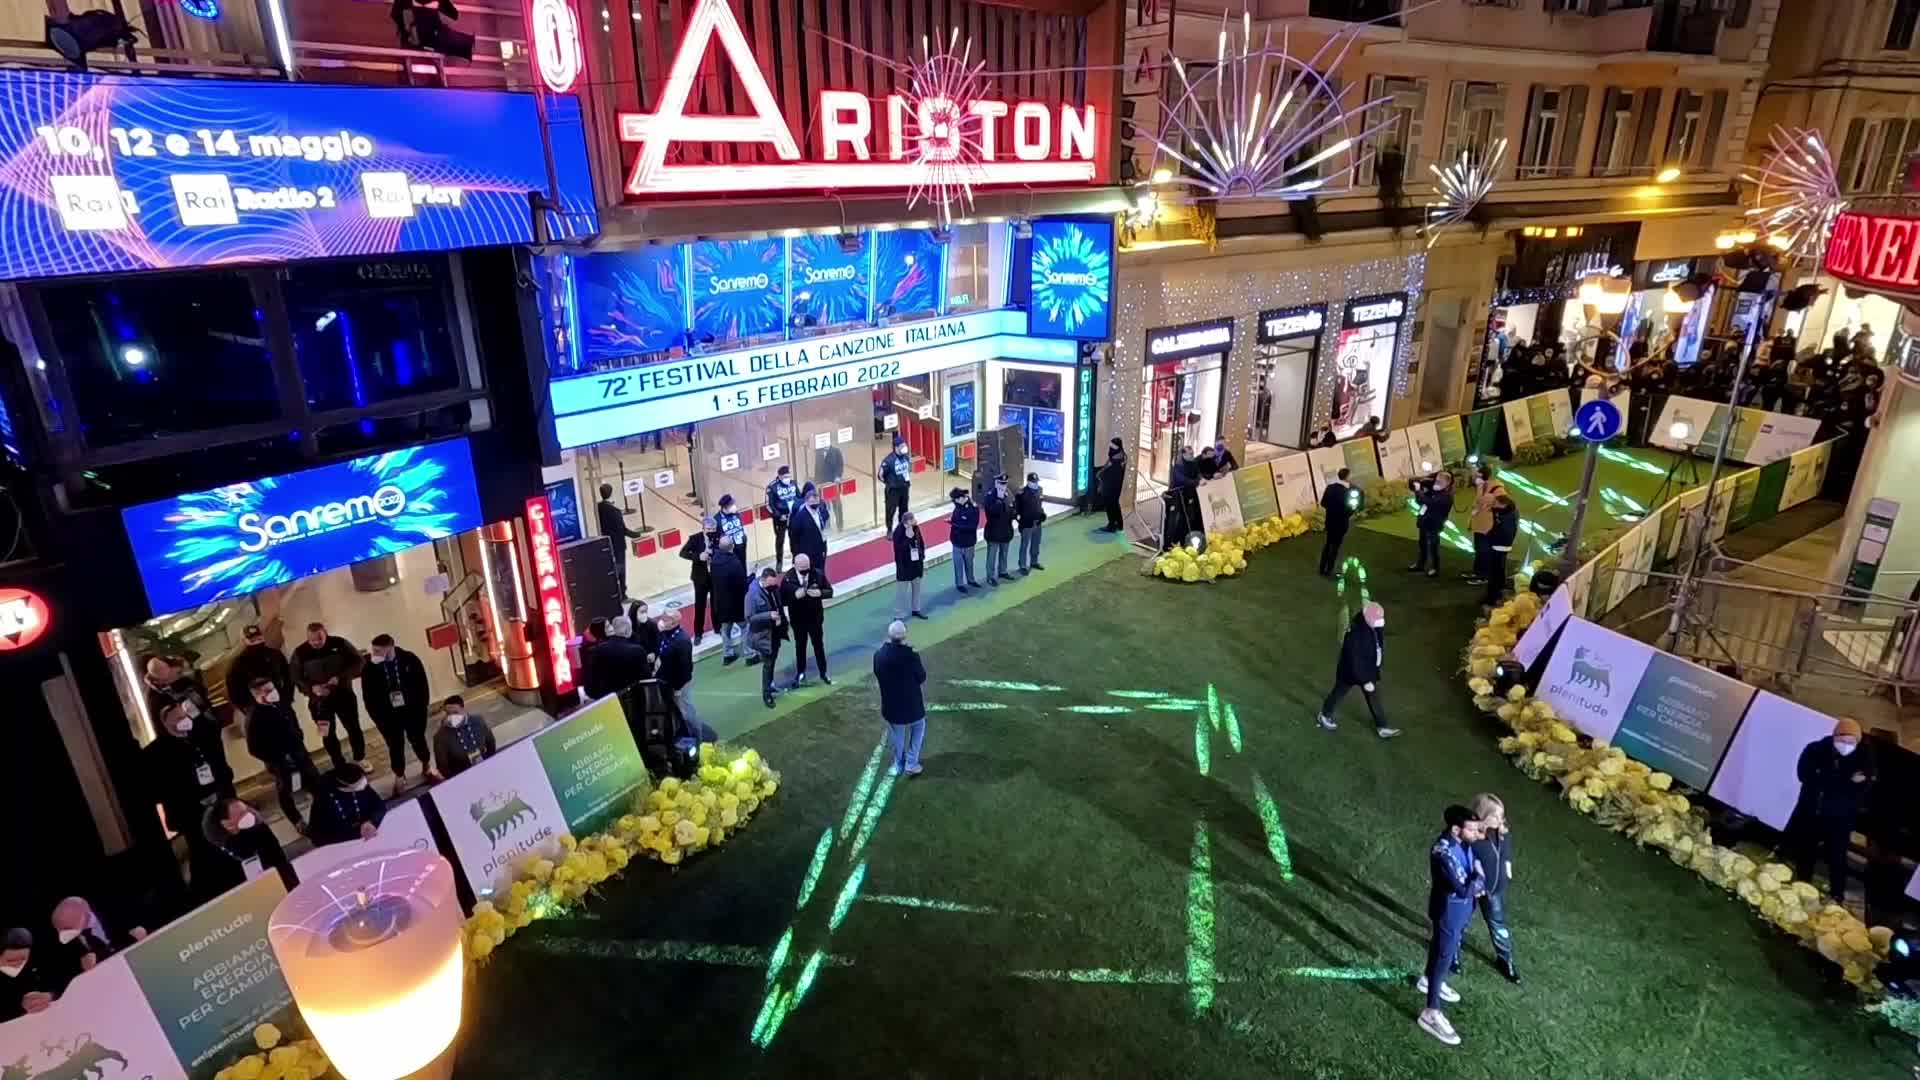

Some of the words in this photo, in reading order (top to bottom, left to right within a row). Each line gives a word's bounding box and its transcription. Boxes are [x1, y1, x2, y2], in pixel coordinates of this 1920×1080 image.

[618, 0, 1097, 192] ARISTON
[37, 125, 104, 162] 10,
[110, 127, 157, 156] 12
[165, 133, 191, 156] e
[197, 128, 240, 156] 14
[248, 130, 372, 161] maggio
[184, 187, 226, 209] Rai
[234, 186, 316, 210] Radio
[317, 186, 335, 207] 2
[709, 272, 769, 295] Sanremo
[804, 264, 856, 285] Sanremo
[1043, 268, 1097, 287] Sanremo
[639, 359, 741, 392] FESTIVAL
[750, 348, 809, 373] DELLA
[820, 332, 896, 361] CANZONE
[905, 321, 966, 344] ITALIANA
[758, 371, 848, 403] FEBBRAIO
[857, 361, 900, 384] 2022
[1079, 369, 1090, 442] CINEMA
[238, 485, 406, 552] Sanremo
[530, 503, 558, 591] CINEMA
[1550, 683, 1609, 718] plenitude
[482, 825, 553, 878] plenitude
[178, 912, 254, 963] plenitude
[191, 937, 269, 991] ABBIAMO
[200, 951, 274, 1000] ENERGIA
[178, 1001, 215, 1031] PER
